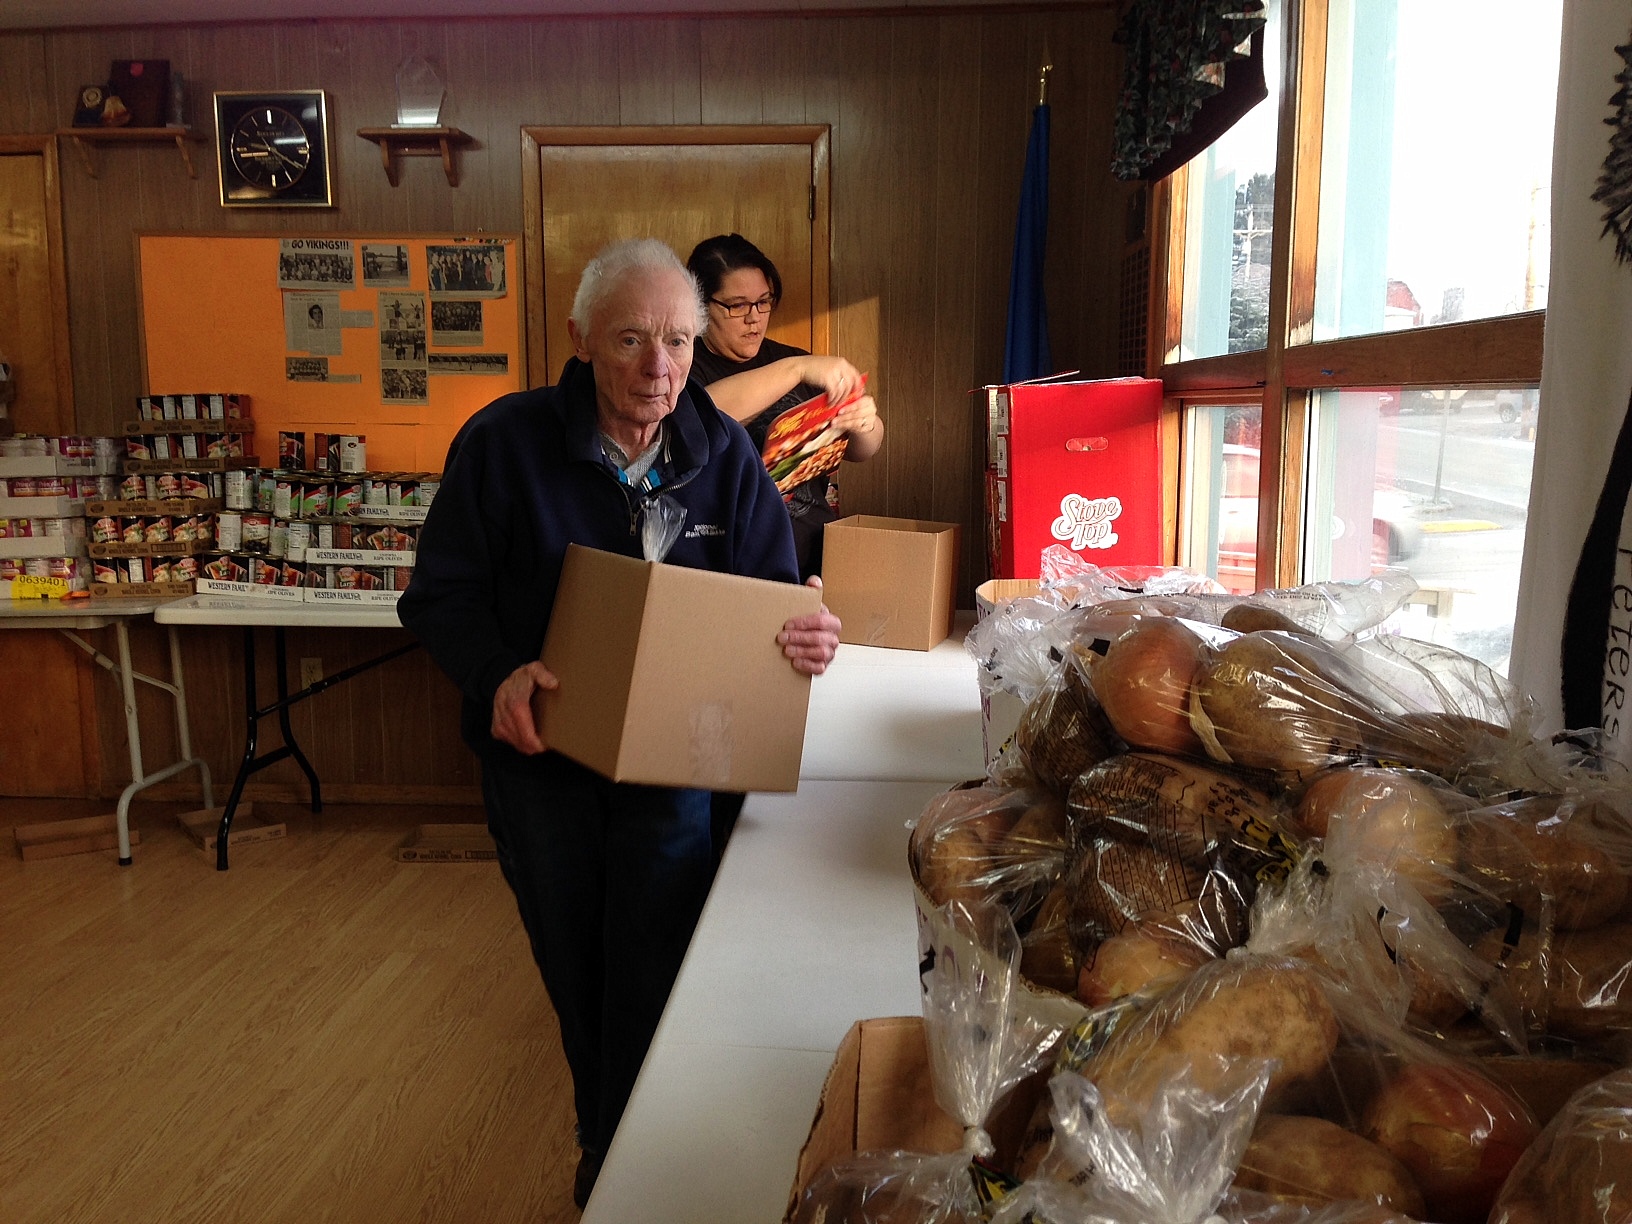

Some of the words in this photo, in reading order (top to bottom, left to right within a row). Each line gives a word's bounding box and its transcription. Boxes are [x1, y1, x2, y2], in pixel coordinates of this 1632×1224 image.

[291, 240, 304, 249] GO
[305, 240, 349, 250] VIKINGS!!!
[1054, 496, 1119, 536] Stove
[1074, 523, 1109, 546] Top
[316, 551, 338, 559] WESTERN
[339, 552, 356, 560] FAMILY
[19, 575, 66, 587] 0639401
[208, 581, 231, 590] WESTERN
[313, 591, 337, 599] WESTERN
[337, 592, 354, 600] FAMILY
